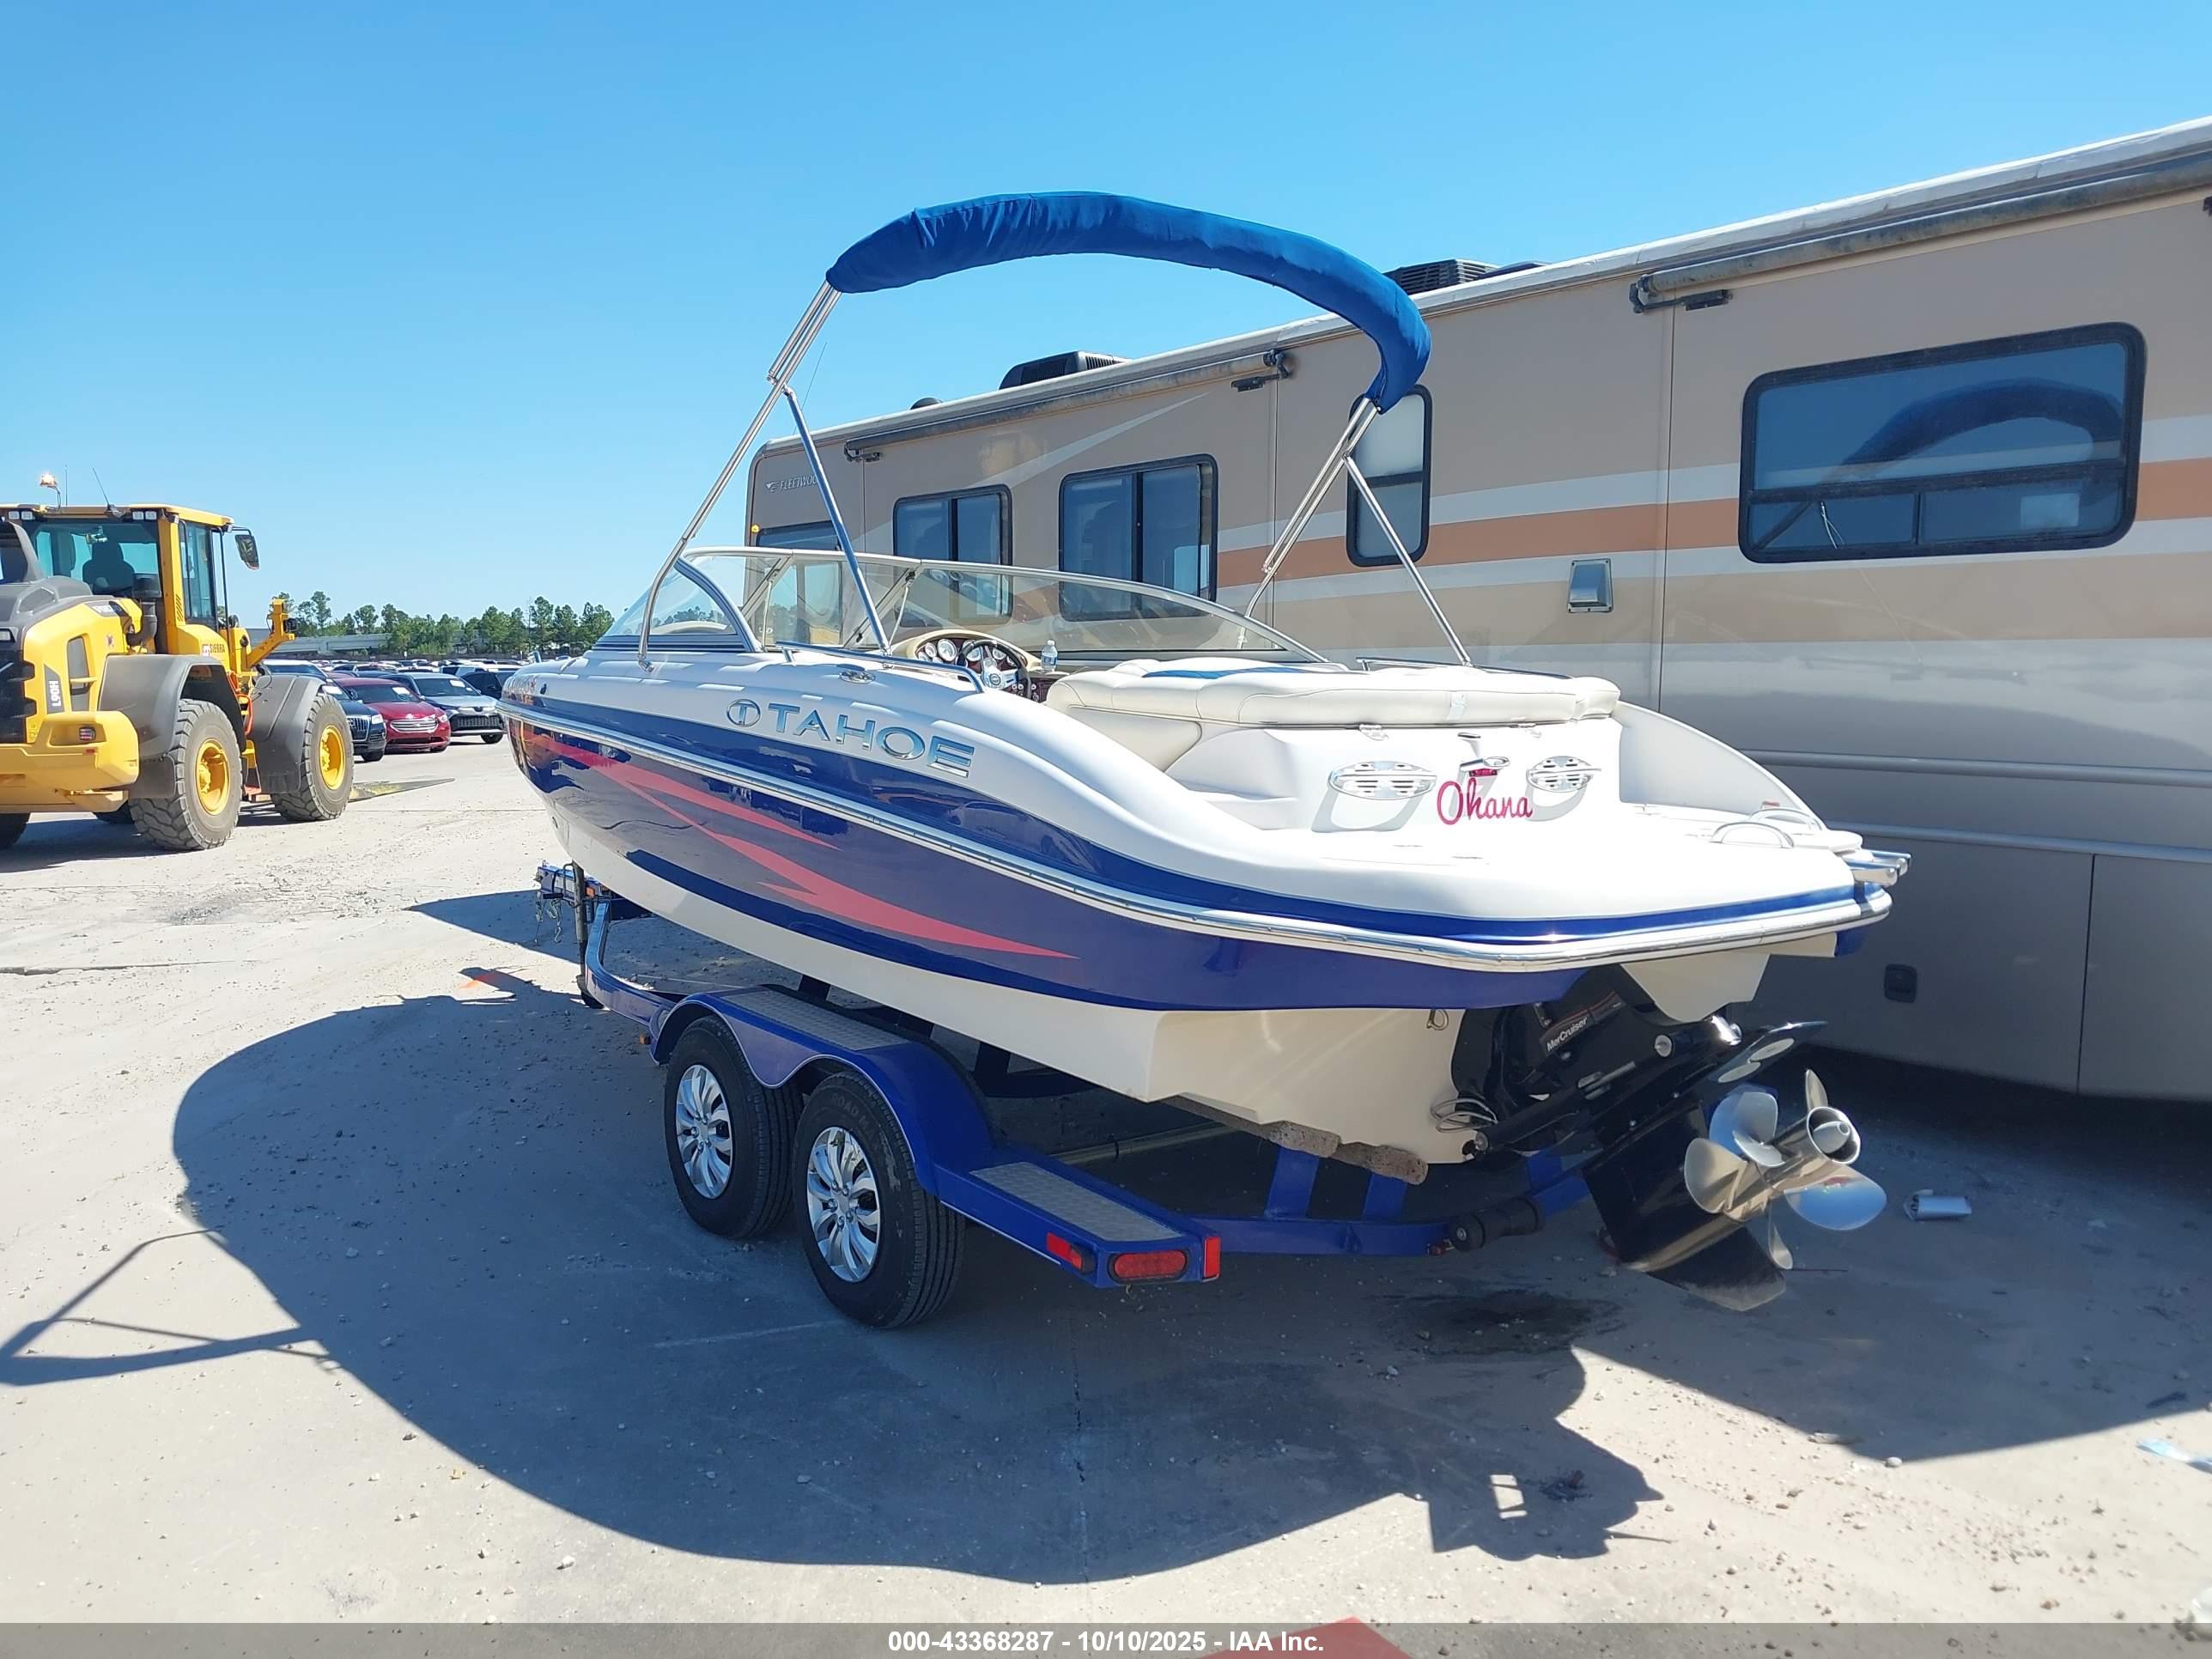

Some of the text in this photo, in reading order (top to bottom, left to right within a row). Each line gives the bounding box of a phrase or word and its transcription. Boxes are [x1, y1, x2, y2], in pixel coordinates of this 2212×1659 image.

[48, 680, 62, 707] L90H
[768, 702, 975, 779] TAHOE
[1437, 777, 1533, 825] Ohana
[1547, 1017, 1588, 1051] MerCruiser
